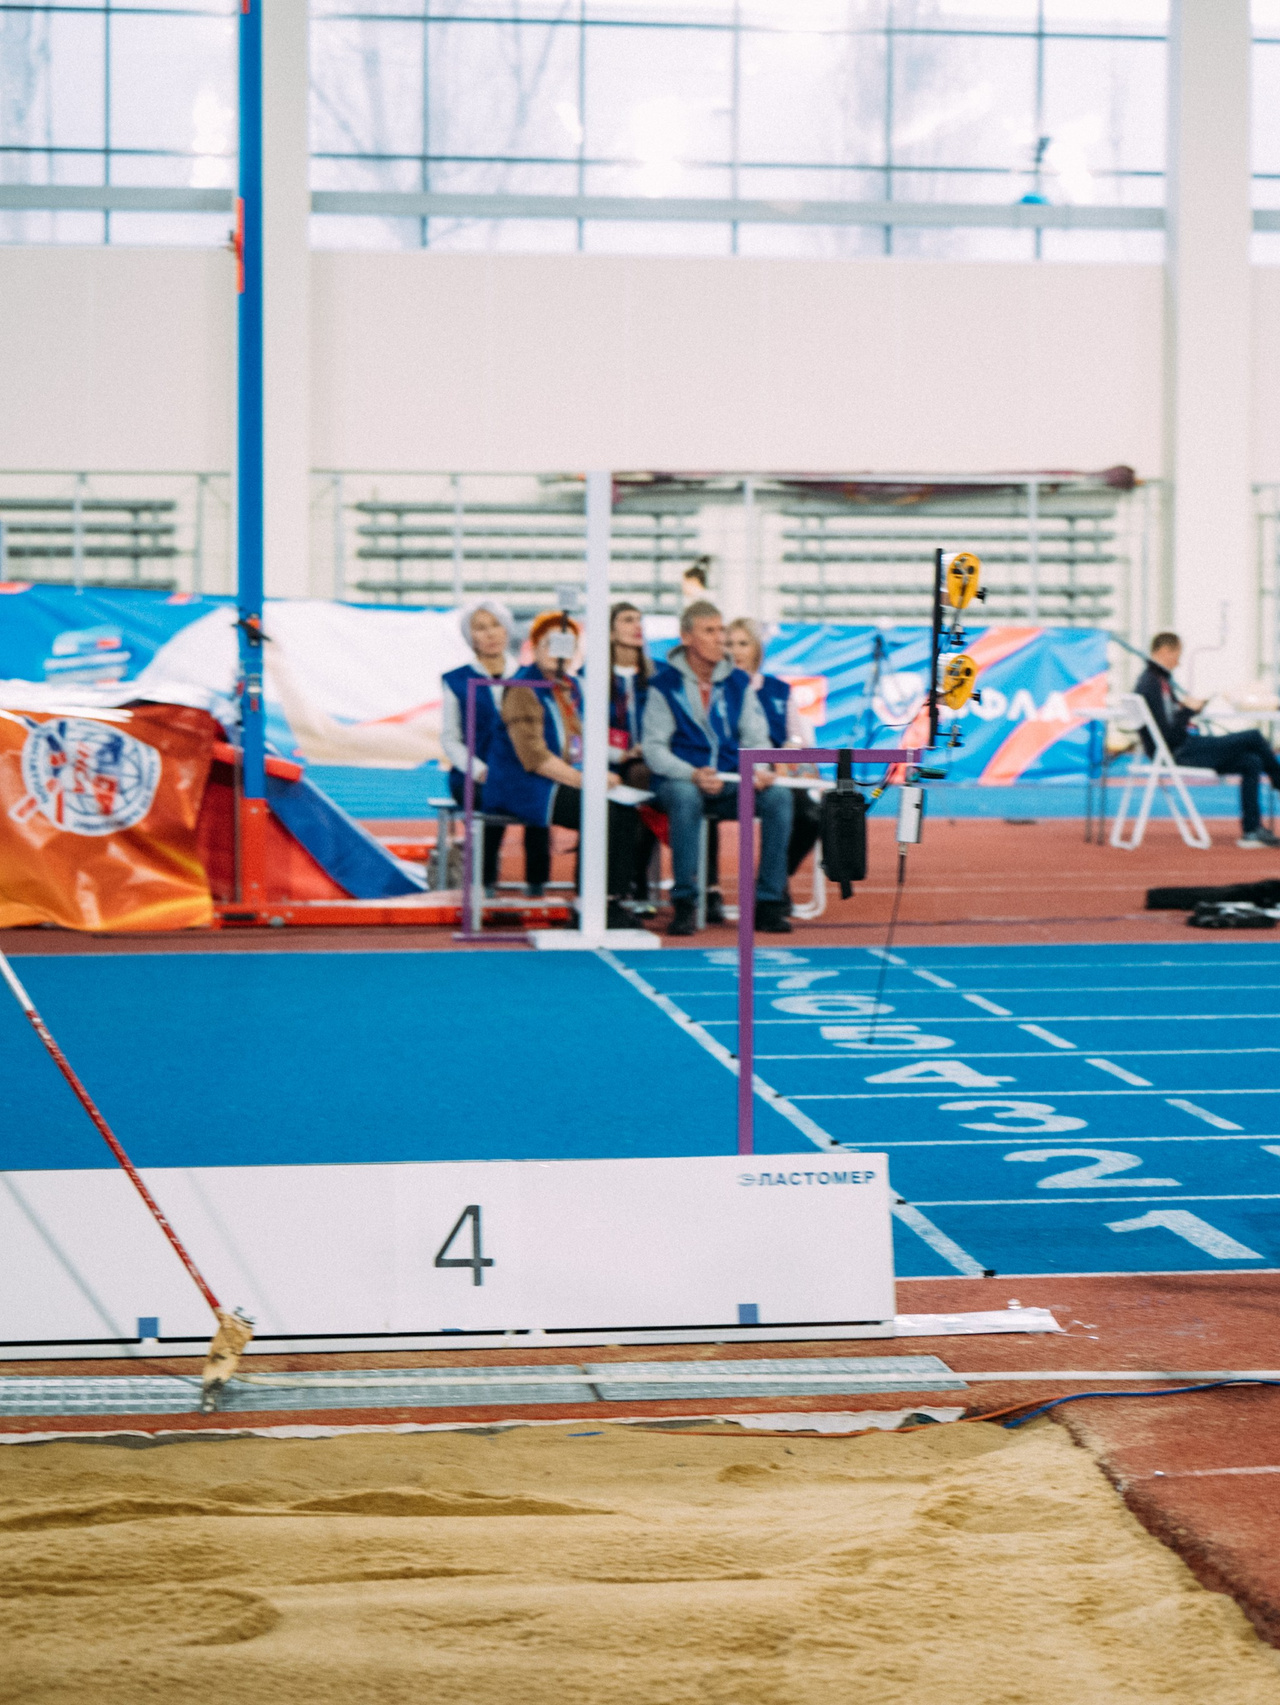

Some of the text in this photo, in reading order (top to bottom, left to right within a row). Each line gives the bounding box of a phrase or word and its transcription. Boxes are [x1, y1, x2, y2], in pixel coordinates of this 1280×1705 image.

[733, 970, 840, 989] 7
[770, 994, 896, 1016] 6
[820, 1025, 956, 1050] 5
[864, 1060, 1017, 1088] 4
[938, 1100, 1089, 1133] 3
[738, 1170, 876, 1187] ЭЛАСТОМЕР
[1003, 1148, 1183, 1189] 2
[434, 1204, 496, 1287] 4
[1103, 1210, 1265, 1259] 1
